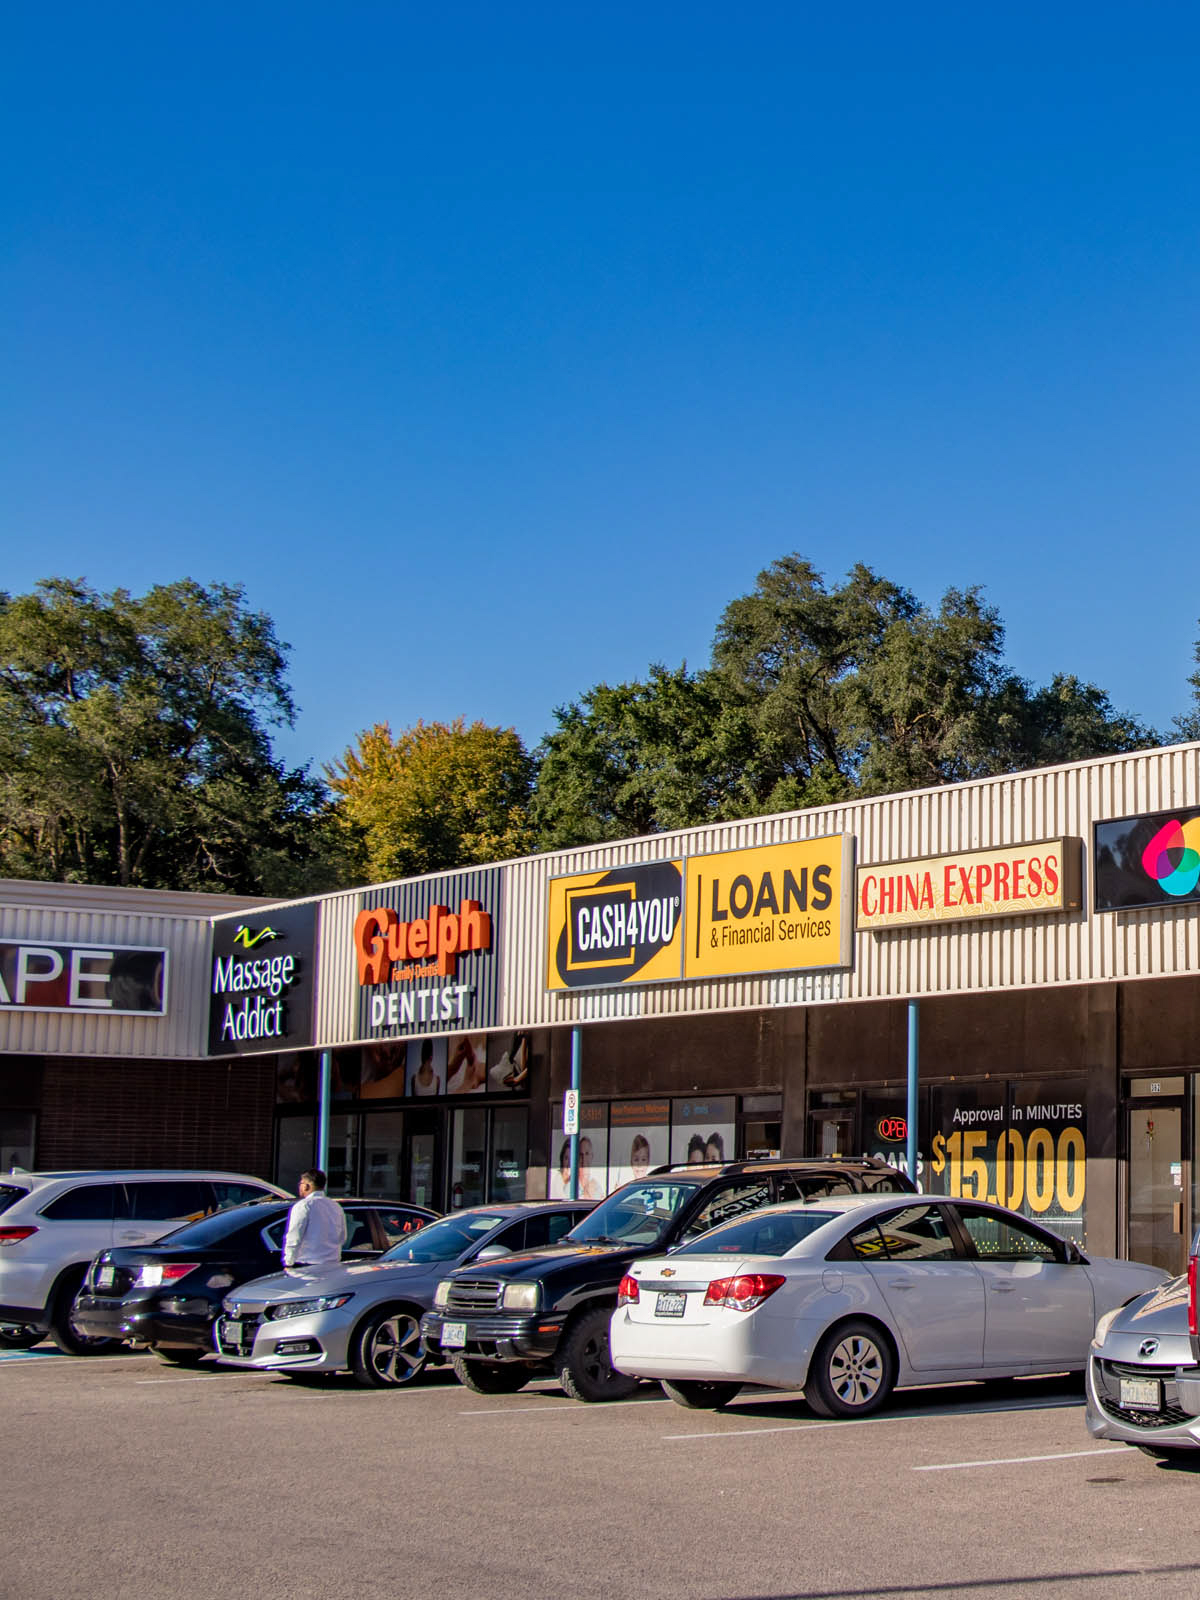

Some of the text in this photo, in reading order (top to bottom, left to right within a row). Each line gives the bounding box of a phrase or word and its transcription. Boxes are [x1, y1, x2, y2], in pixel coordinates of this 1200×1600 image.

[711, 864, 833, 922] LOANS
[861, 855, 1059, 917] CHINA EXPRESS
[354, 897, 489, 986] Guelph
[710, 916, 832, 948] & Financial Services
[0, 946, 114, 1007] PE
[214, 954, 295, 996] Massage
[221, 995, 283, 1041] Addict
[371, 984, 470, 1027] DENTIST
[952, 1103, 1083, 1126] Approval in MINUTES
